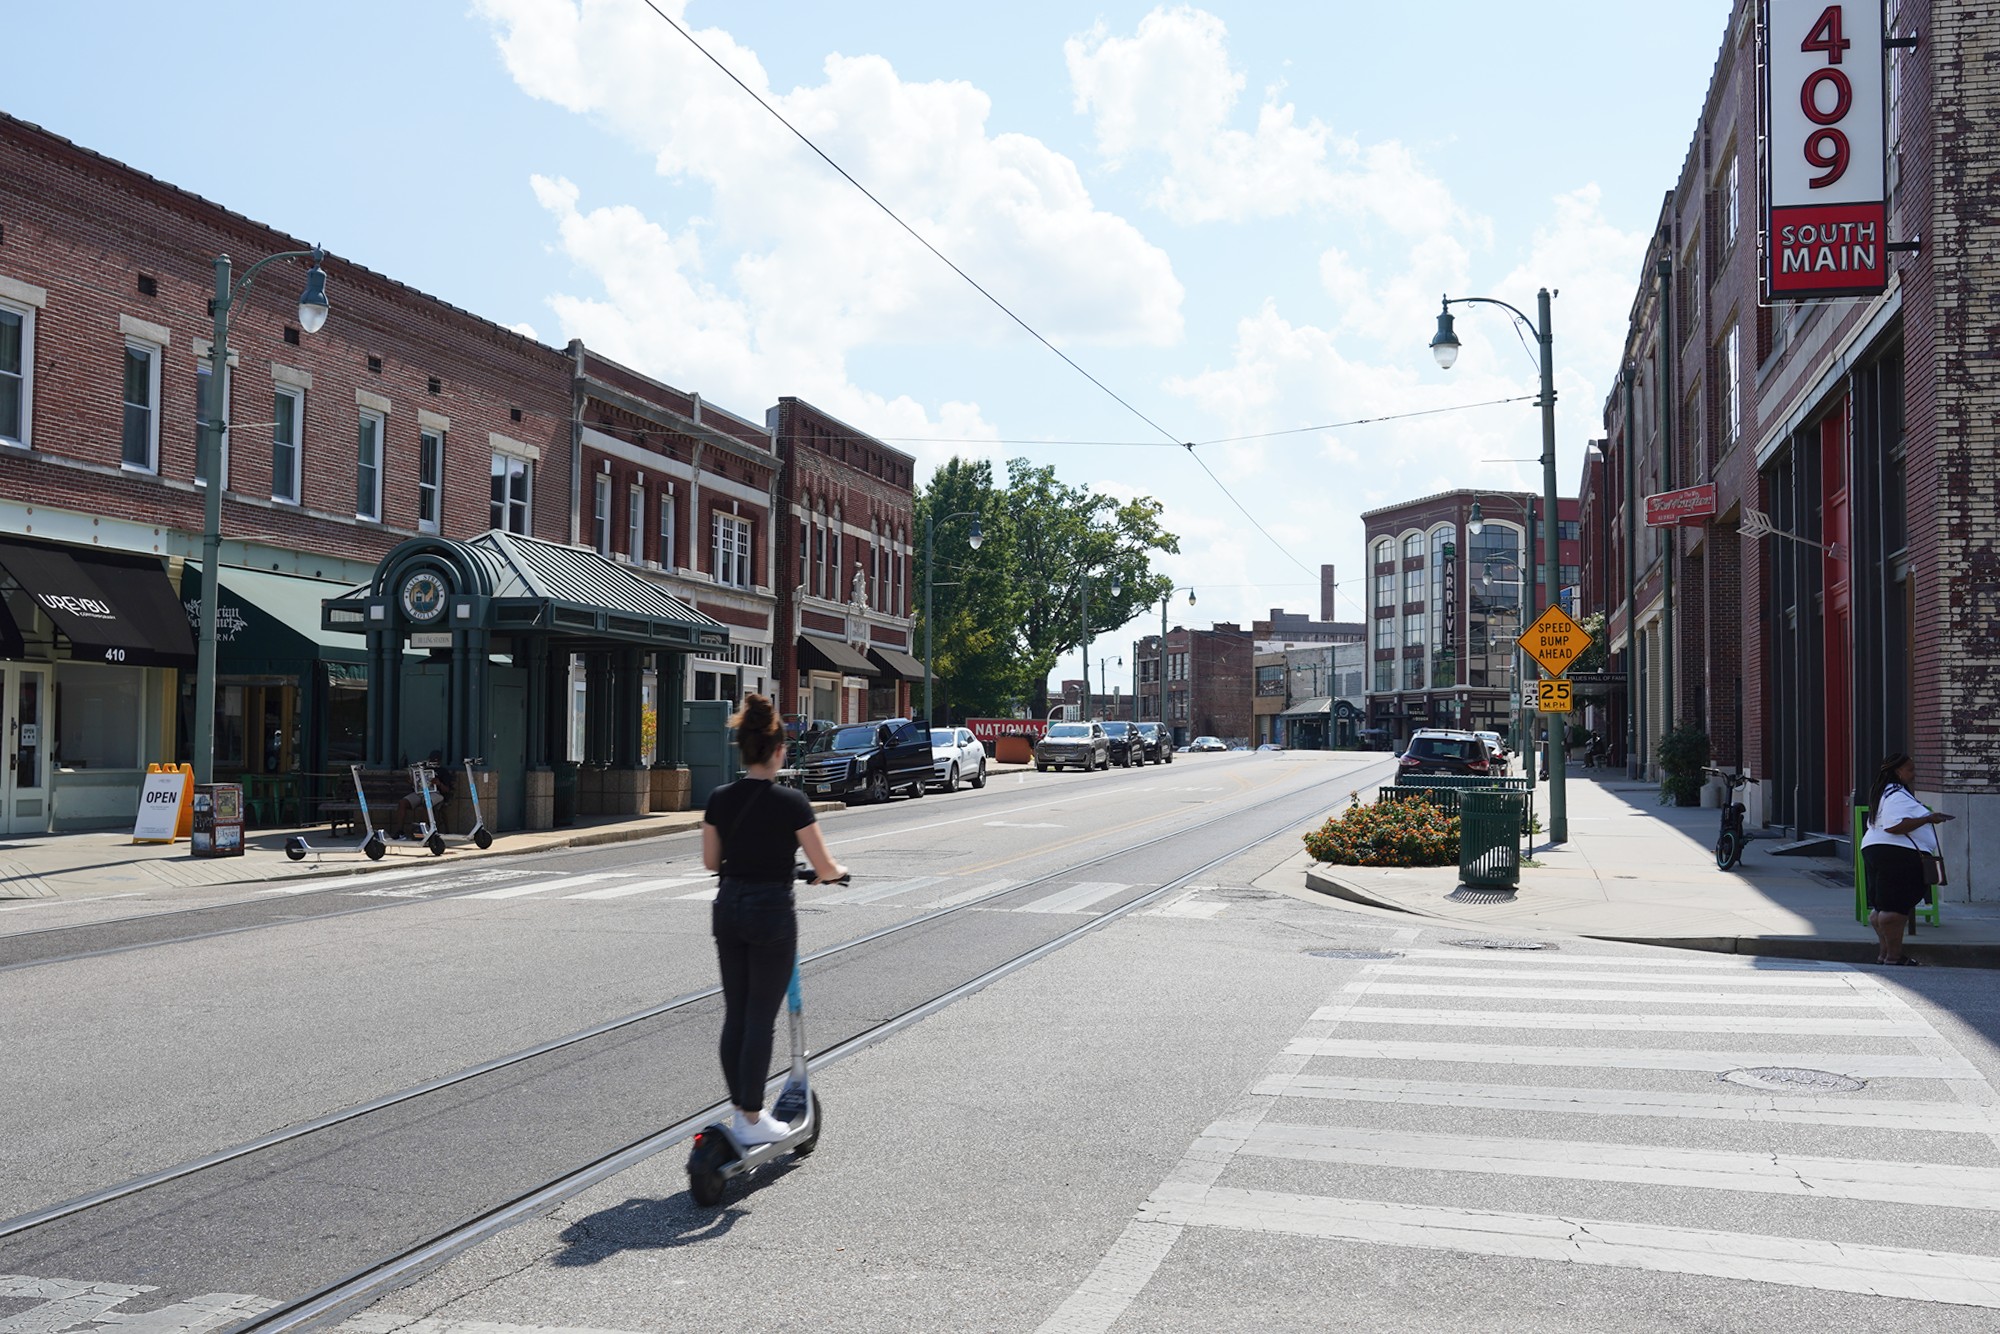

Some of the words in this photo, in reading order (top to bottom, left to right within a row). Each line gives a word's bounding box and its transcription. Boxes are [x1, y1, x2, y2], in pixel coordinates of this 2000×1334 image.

[1801, 5, 1852, 189] 409
[1781, 222, 1876, 246] SOUTH
[1781, 244, 1876, 273] MAIN
[38, 593, 110, 616] UREVBU
[1446, 562, 1454, 646] ARRIVE
[1538, 622, 1571, 633] SPEED
[1540, 636, 1569, 646] BUMP
[105, 648, 125, 661] 410
[1538, 648, 1572, 659] AHEAD
[1541, 684, 1569, 699] 25
[146, 791, 177, 804] OPEN
